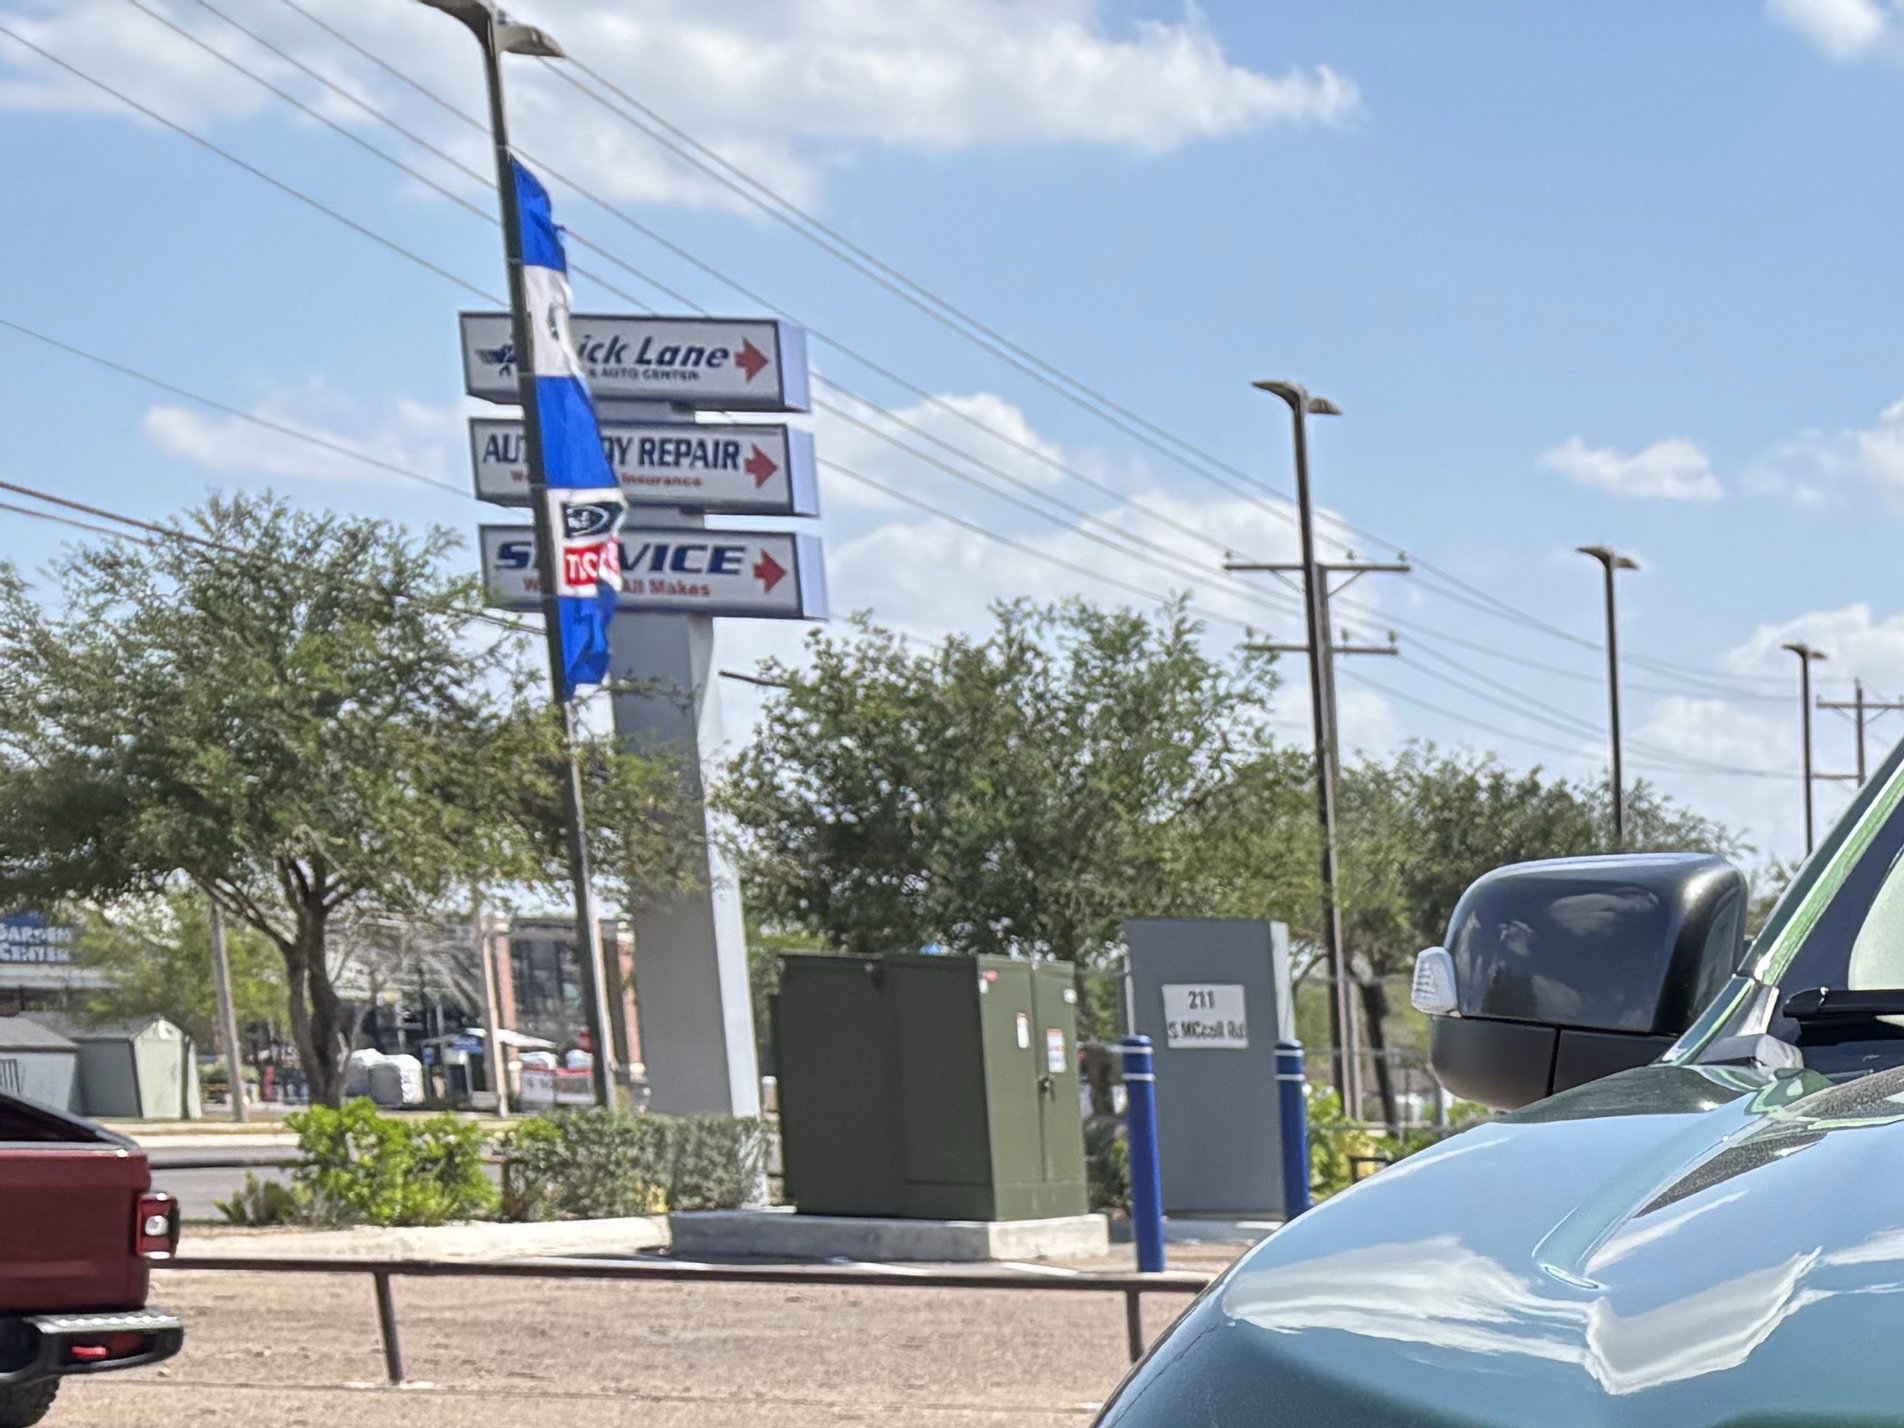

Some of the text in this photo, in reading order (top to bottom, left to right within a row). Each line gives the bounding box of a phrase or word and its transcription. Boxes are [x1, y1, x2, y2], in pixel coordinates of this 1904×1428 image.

[635, 335, 729, 368] Lane
[639, 438, 740, 470] REPAIR
[495, 541, 746, 576] SVICE
[650, 579, 710, 597] Makes
[1188, 990, 1215, 1010] 211
